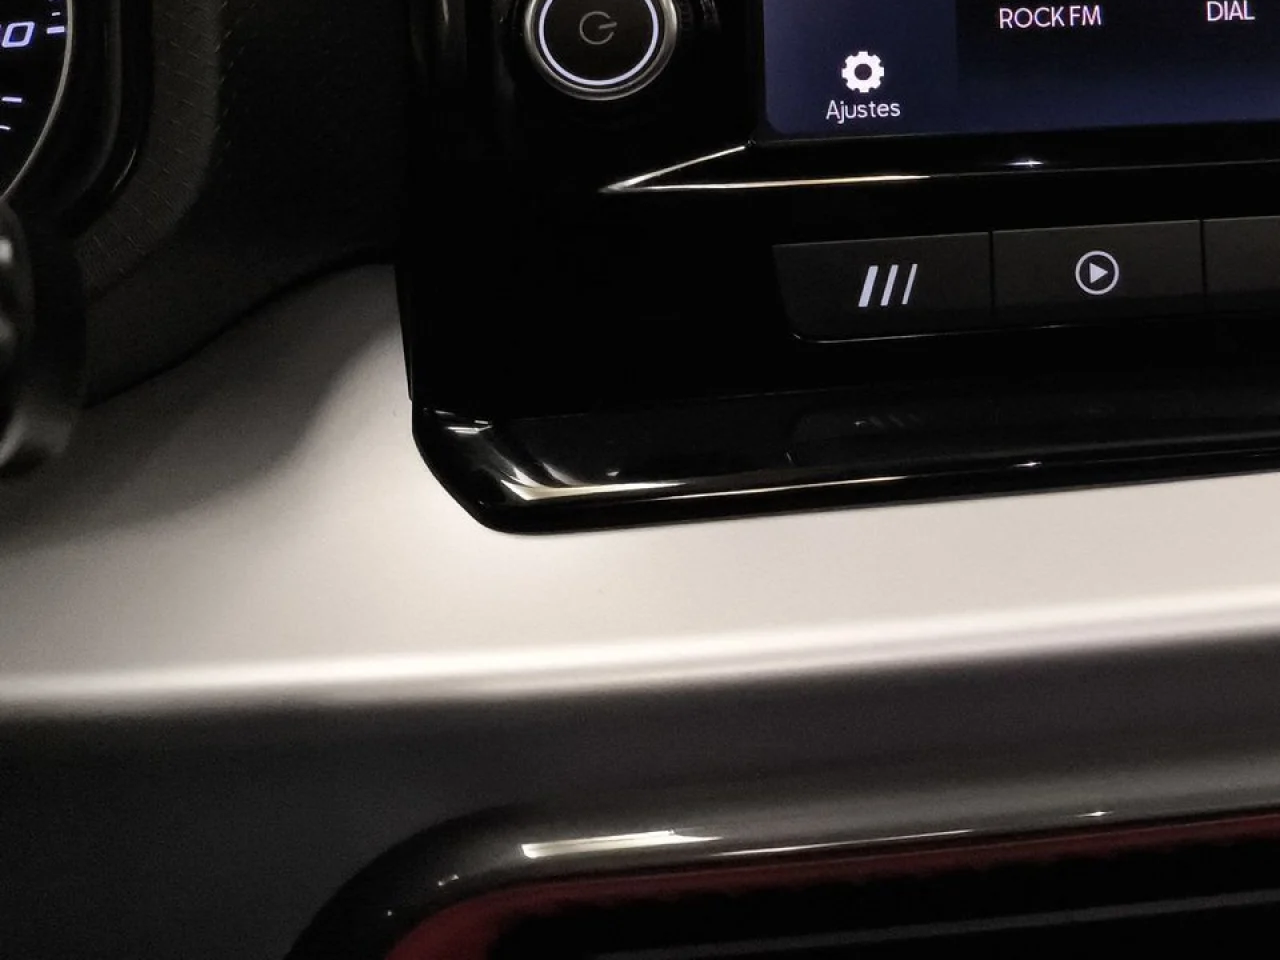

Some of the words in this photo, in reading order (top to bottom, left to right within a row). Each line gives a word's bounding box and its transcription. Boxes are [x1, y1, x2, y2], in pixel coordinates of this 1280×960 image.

[999, 6, 1065, 29] ROCK
[1069, 5, 1103, 26] FM
[1206, 0, 1256, 22] DIAL
[825, 99, 902, 125] Ajustes
